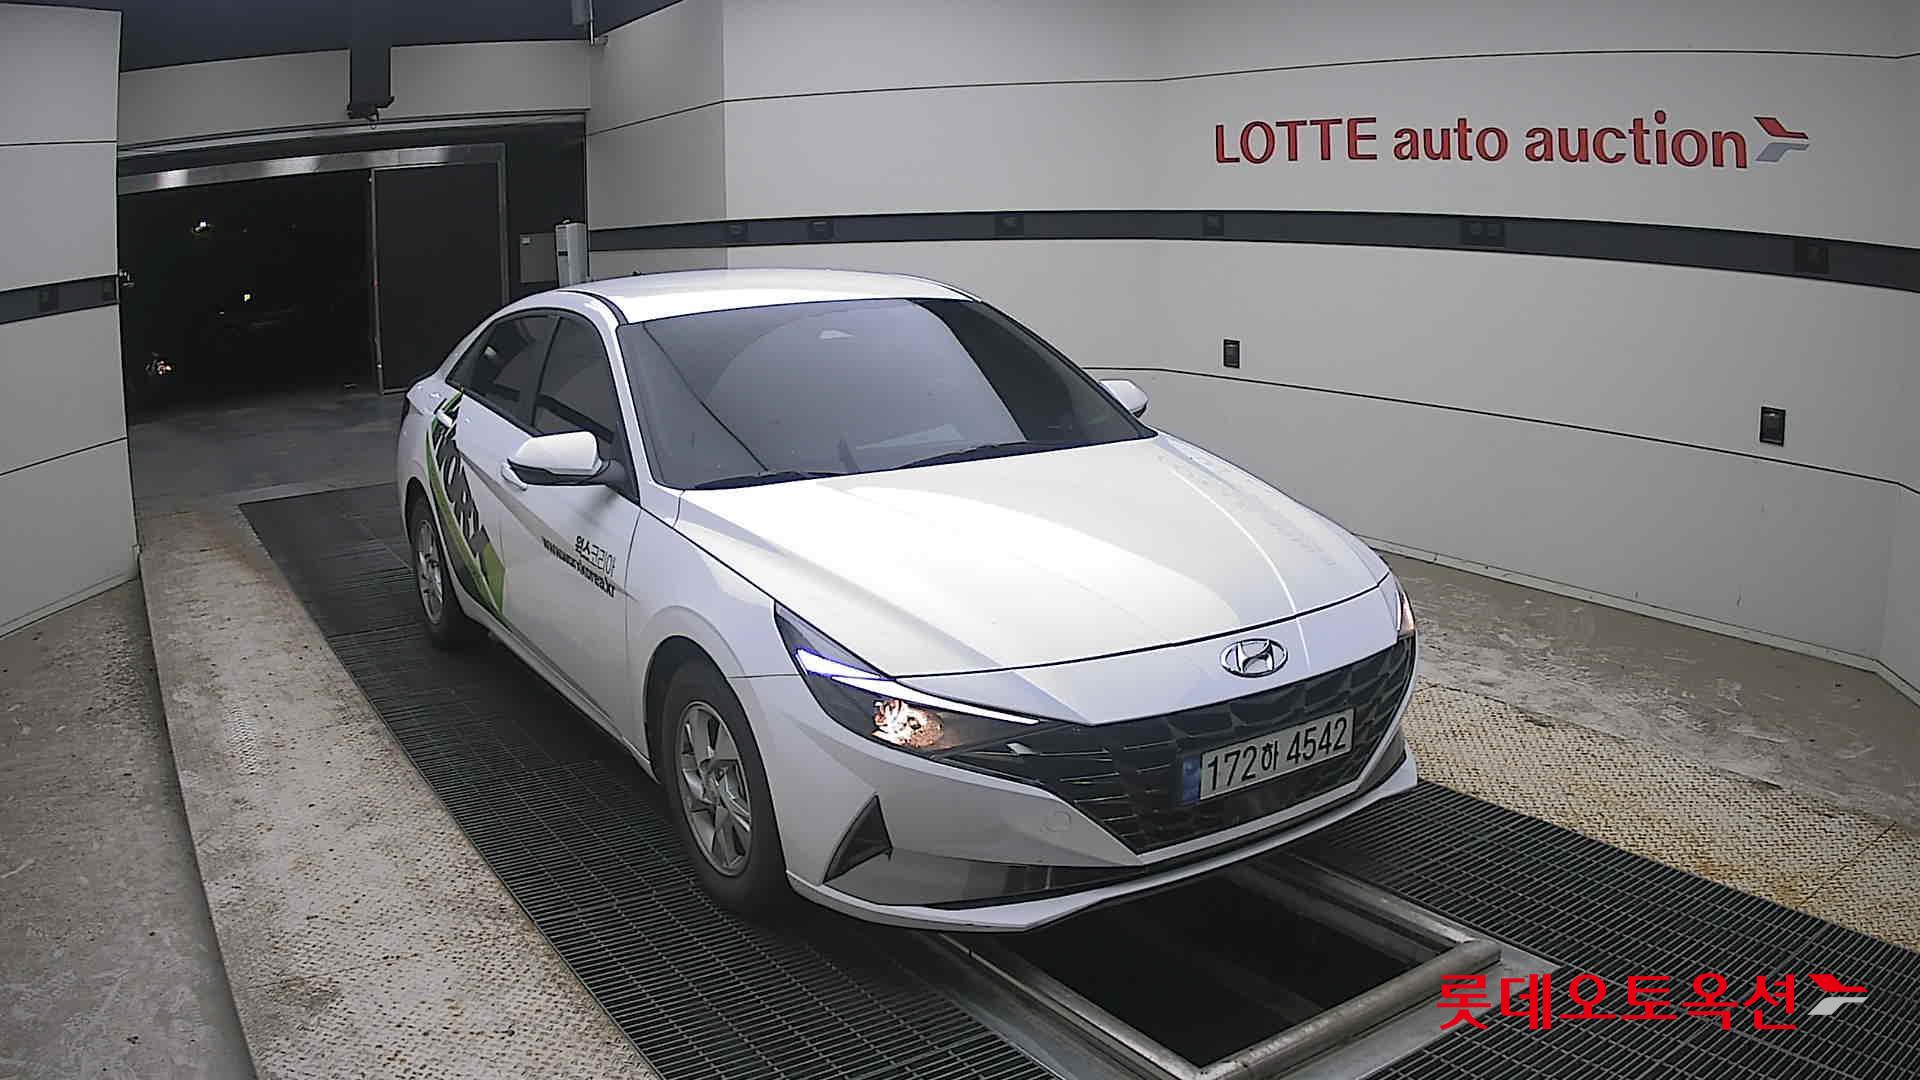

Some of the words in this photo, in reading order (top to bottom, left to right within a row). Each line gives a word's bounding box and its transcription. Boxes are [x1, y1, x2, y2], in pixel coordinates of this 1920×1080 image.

[1215, 117, 1377, 164] LOTTE
[1393, 118, 1509, 161] auto
[1524, 110, 1748, 169] auction
[1208, 741, 1279, 790] 172하
[1287, 717, 1348, 764] 4542
